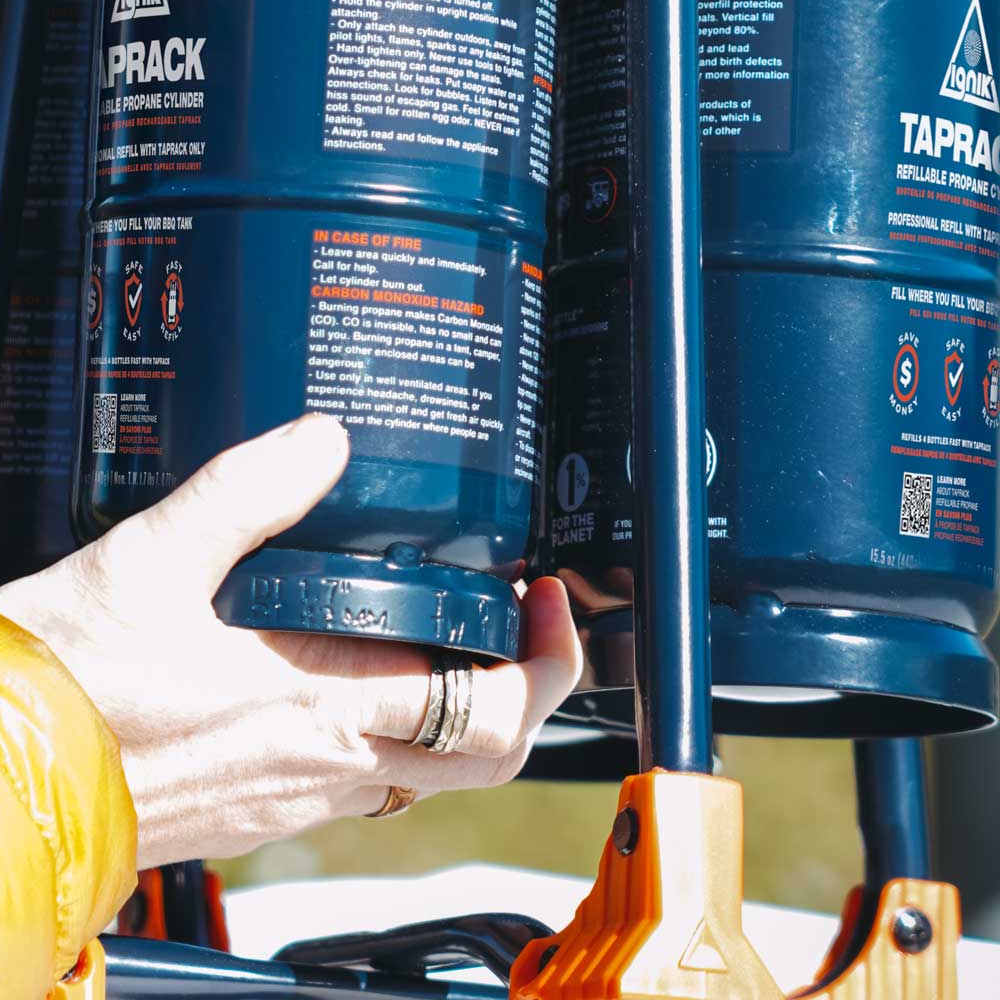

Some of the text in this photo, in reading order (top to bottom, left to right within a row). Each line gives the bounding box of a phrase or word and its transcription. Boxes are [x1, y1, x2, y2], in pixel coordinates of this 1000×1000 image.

[698, 0, 783, 10] overfill protection
[331, 8, 379, 24] attaching.
[722, 13, 774, 22] Vertical fill
[734, 26, 759, 35] 80%.
[707, 44, 749, 53] and lead
[328, 53, 407, 73] Over-tightening
[700, 57, 782, 66] and birth defects
[733, 71, 789, 80] information
[123, 94, 161, 112] PROPANE
[164, 92, 204, 108] CYLINDER
[741, 100, 751, 109] of
[721, 113, 761, 122] which is
[703, 127, 741, 135] of other
[324, 136, 386, 151] instructions.
[331, 124, 498, 158] Always read and follow the appliance
[117, 144, 138, 159] REFILL
[140, 143, 156, 156] WITH
[158, 142, 188, 155] TAPRACK
[190, 142, 205, 155] ONLY
[896, 164, 988, 196] REFILLABLE PROPANE
[114, 219, 128, 232] YOU
[129, 218, 142, 230] FILL
[144, 217, 160, 230] YOUR
[163, 217, 176, 230] BBQ
[177, 217, 193, 230] TANK
[888, 212, 982, 240] PROFESSIONAL REFILL WITH
[314, 230, 421, 250] IN CASE OF FIRE
[125, 260, 143, 274] SAFE
[166, 260, 182, 273] FAST
[313, 258, 378, 276] Call for help.
[321, 245, 487, 278] Leave area quickly and immediately.
[320, 272, 425, 292] Let cylinder burn out.
[311, 285, 484, 316] CARBON MONOXIDE HAZARD
[891, 286, 984, 312] FILL WHERE YOU FILL YOUR
[318, 300, 503, 334] Burning propane makes Carbon Monoxide
[123, 328, 141, 342] EASY
[898, 331, 920, 348] SAVE
[946, 338, 965, 353] SAFE
[308, 355, 365, 371] dangerous.
[889, 394, 918, 416] MONEY
[941, 406, 961, 421] EASY
[901, 432, 922, 442] REFILLS
[927, 436, 948, 446] BOTTLES
[949, 438, 961, 446] FAST
[962, 438, 972, 448] WITH
[972, 440, 992, 452] TAPRACK
[937, 475, 952, 485] LEARN
[572, 512, 594, 526] THE
[708, 517, 727, 526] WITH
[552, 527, 594, 547] PLANET
